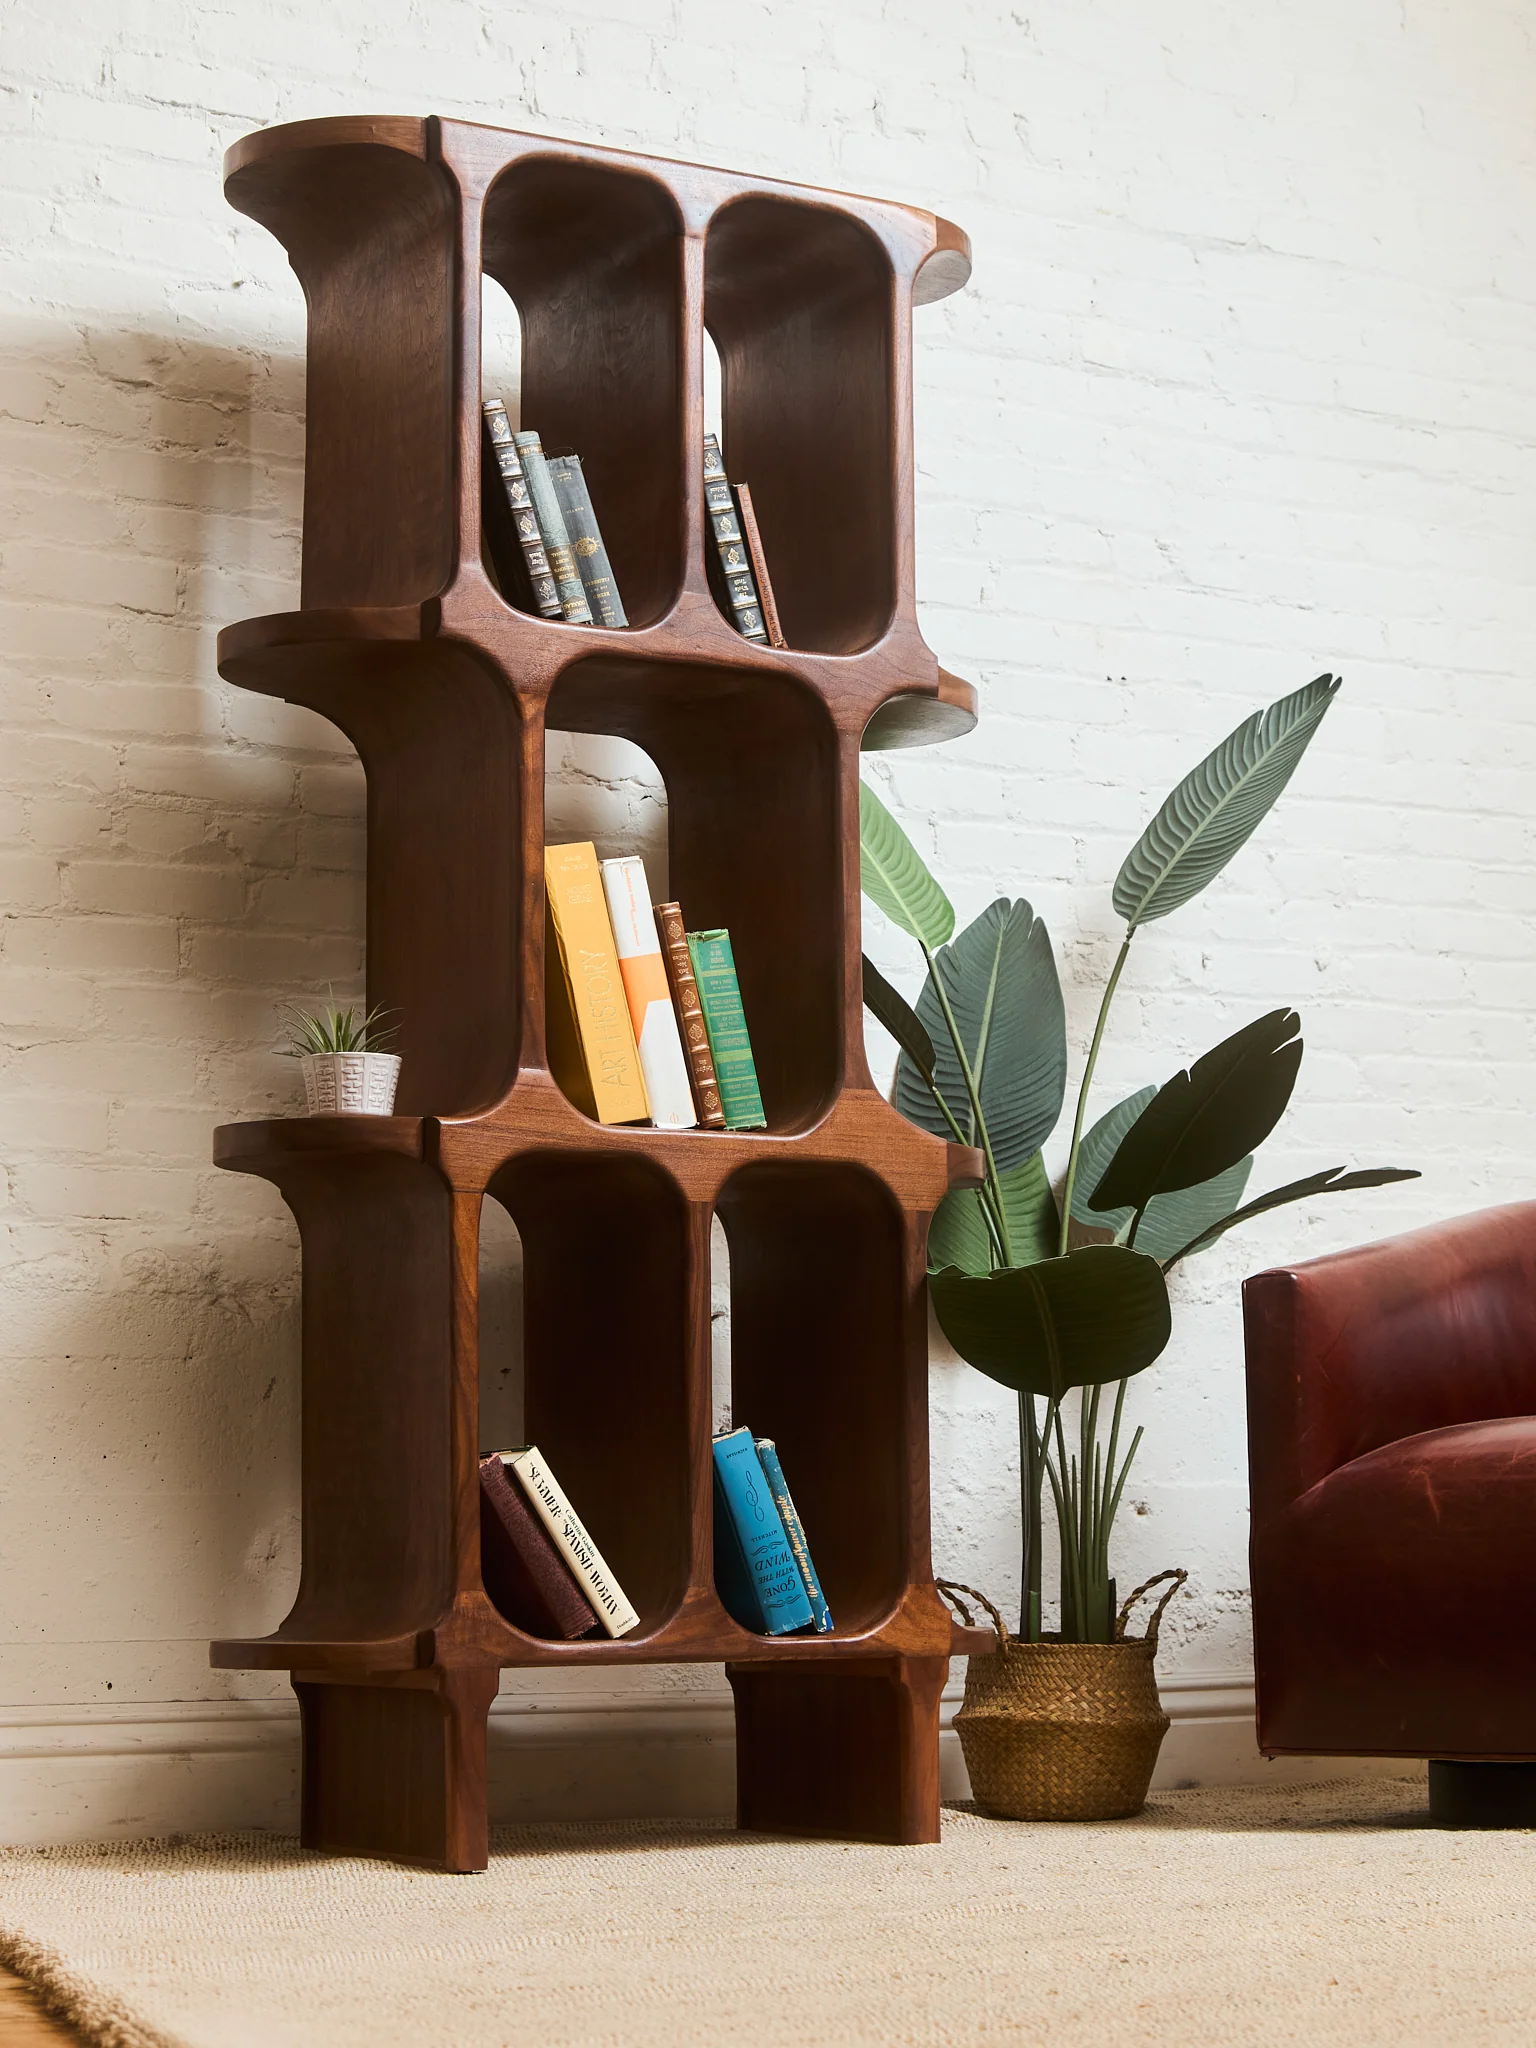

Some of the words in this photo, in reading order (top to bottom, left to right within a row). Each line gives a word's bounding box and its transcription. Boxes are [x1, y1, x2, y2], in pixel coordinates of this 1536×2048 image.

[752, 545, 763, 563] BASIC
[770, 626, 781, 643] OOK
[579, 949, 622, 1043] HISTORY
[600, 1049, 630, 1087] ART
[528, 1466, 561, 1518] SUMMER
[777, 1495, 793, 1526] couple
[565, 1509, 583, 1539] Catherine
[582, 1536, 595, 1558] Gaskin
[751, 1530, 778, 1542] MITCHELL
[754, 1551, 791, 1571] WIND
[788, 1527, 813, 1582] moonflower
[562, 1523, 594, 1571] SPANISH
[589, 1570, 620, 1616] WOMAN
[758, 1571, 774, 1584] THE
[776, 1566, 794, 1579] WITH
[764, 1577, 796, 1598] GONE
[807, 1583, 819, 1598] the
